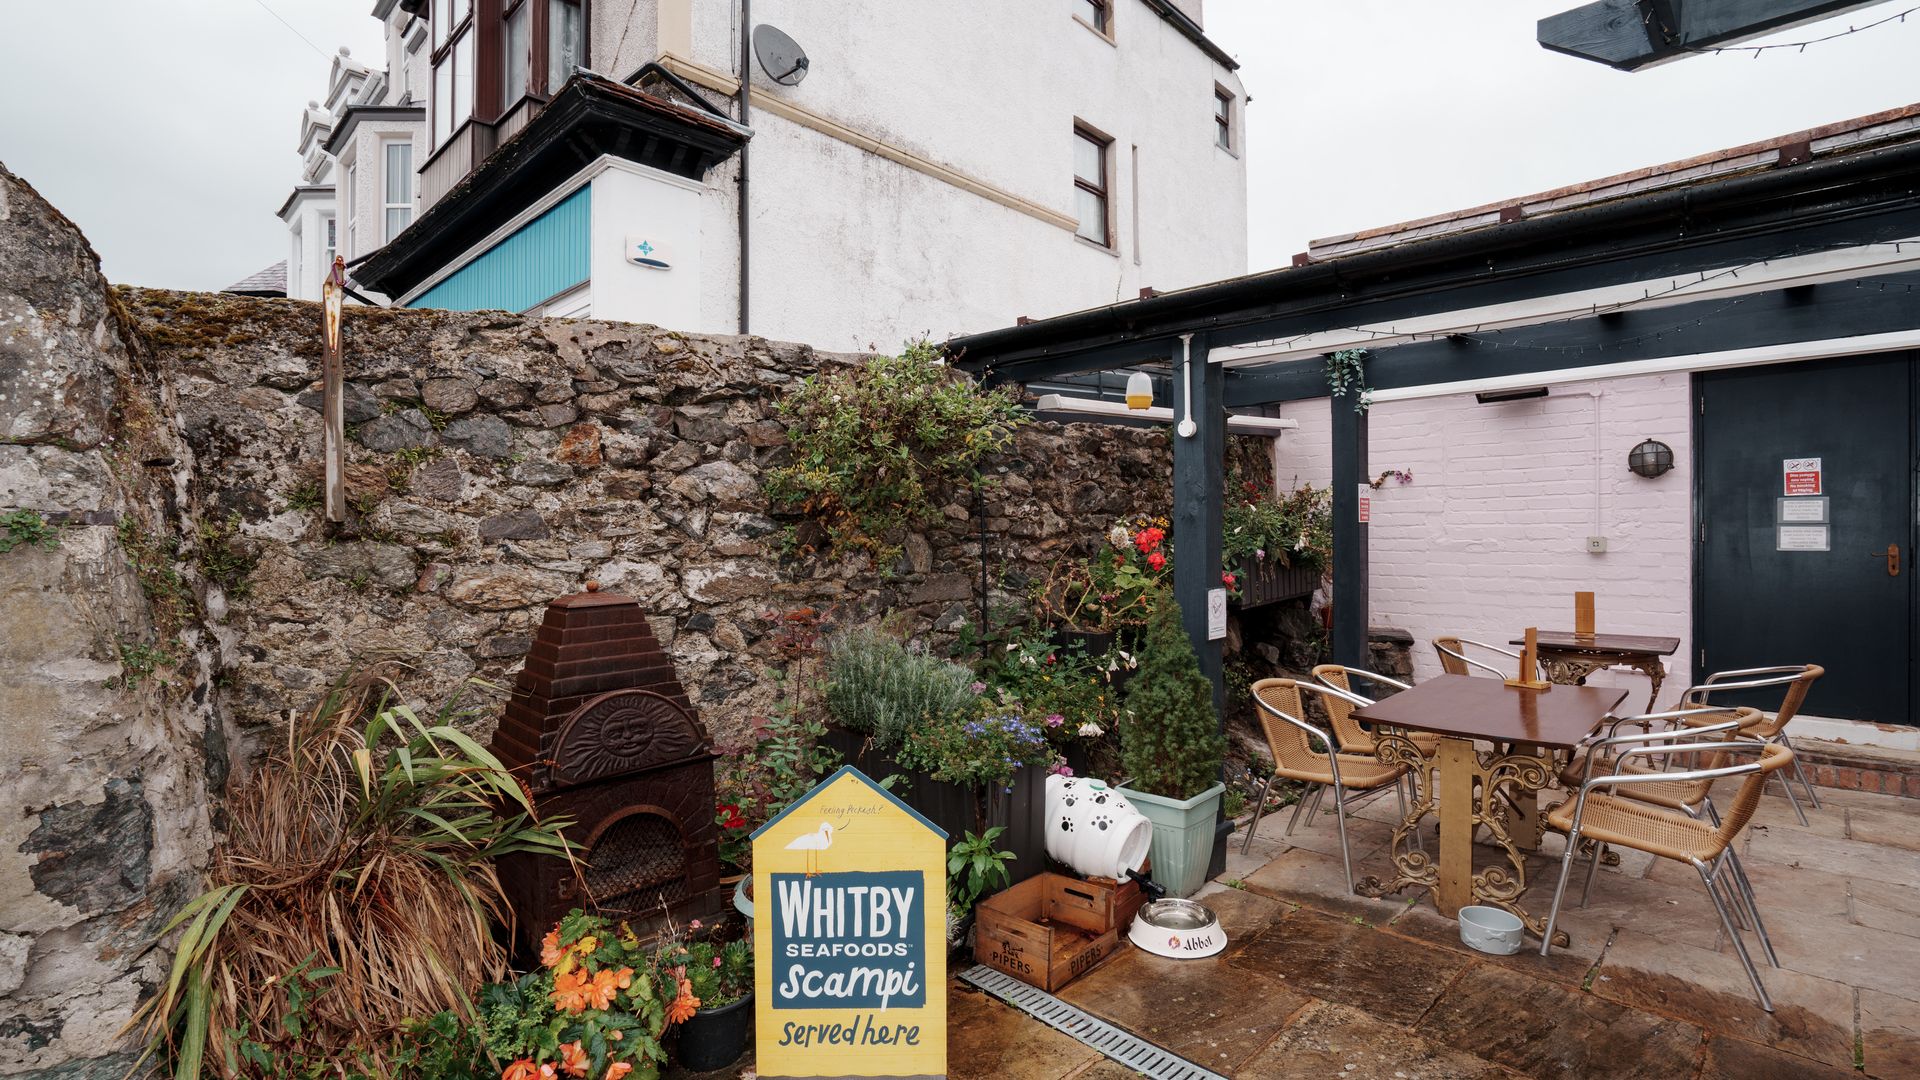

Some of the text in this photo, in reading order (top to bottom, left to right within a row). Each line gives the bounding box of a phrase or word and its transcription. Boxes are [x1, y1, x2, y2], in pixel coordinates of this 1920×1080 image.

[820, 805, 845, 819] Feeling
[778, 880, 915, 938] WHITBY
[992, 951, 1031, 975] PIPERS
[1070, 943, 1102, 975] PIPERS
[861, 1014, 920, 1046] here
